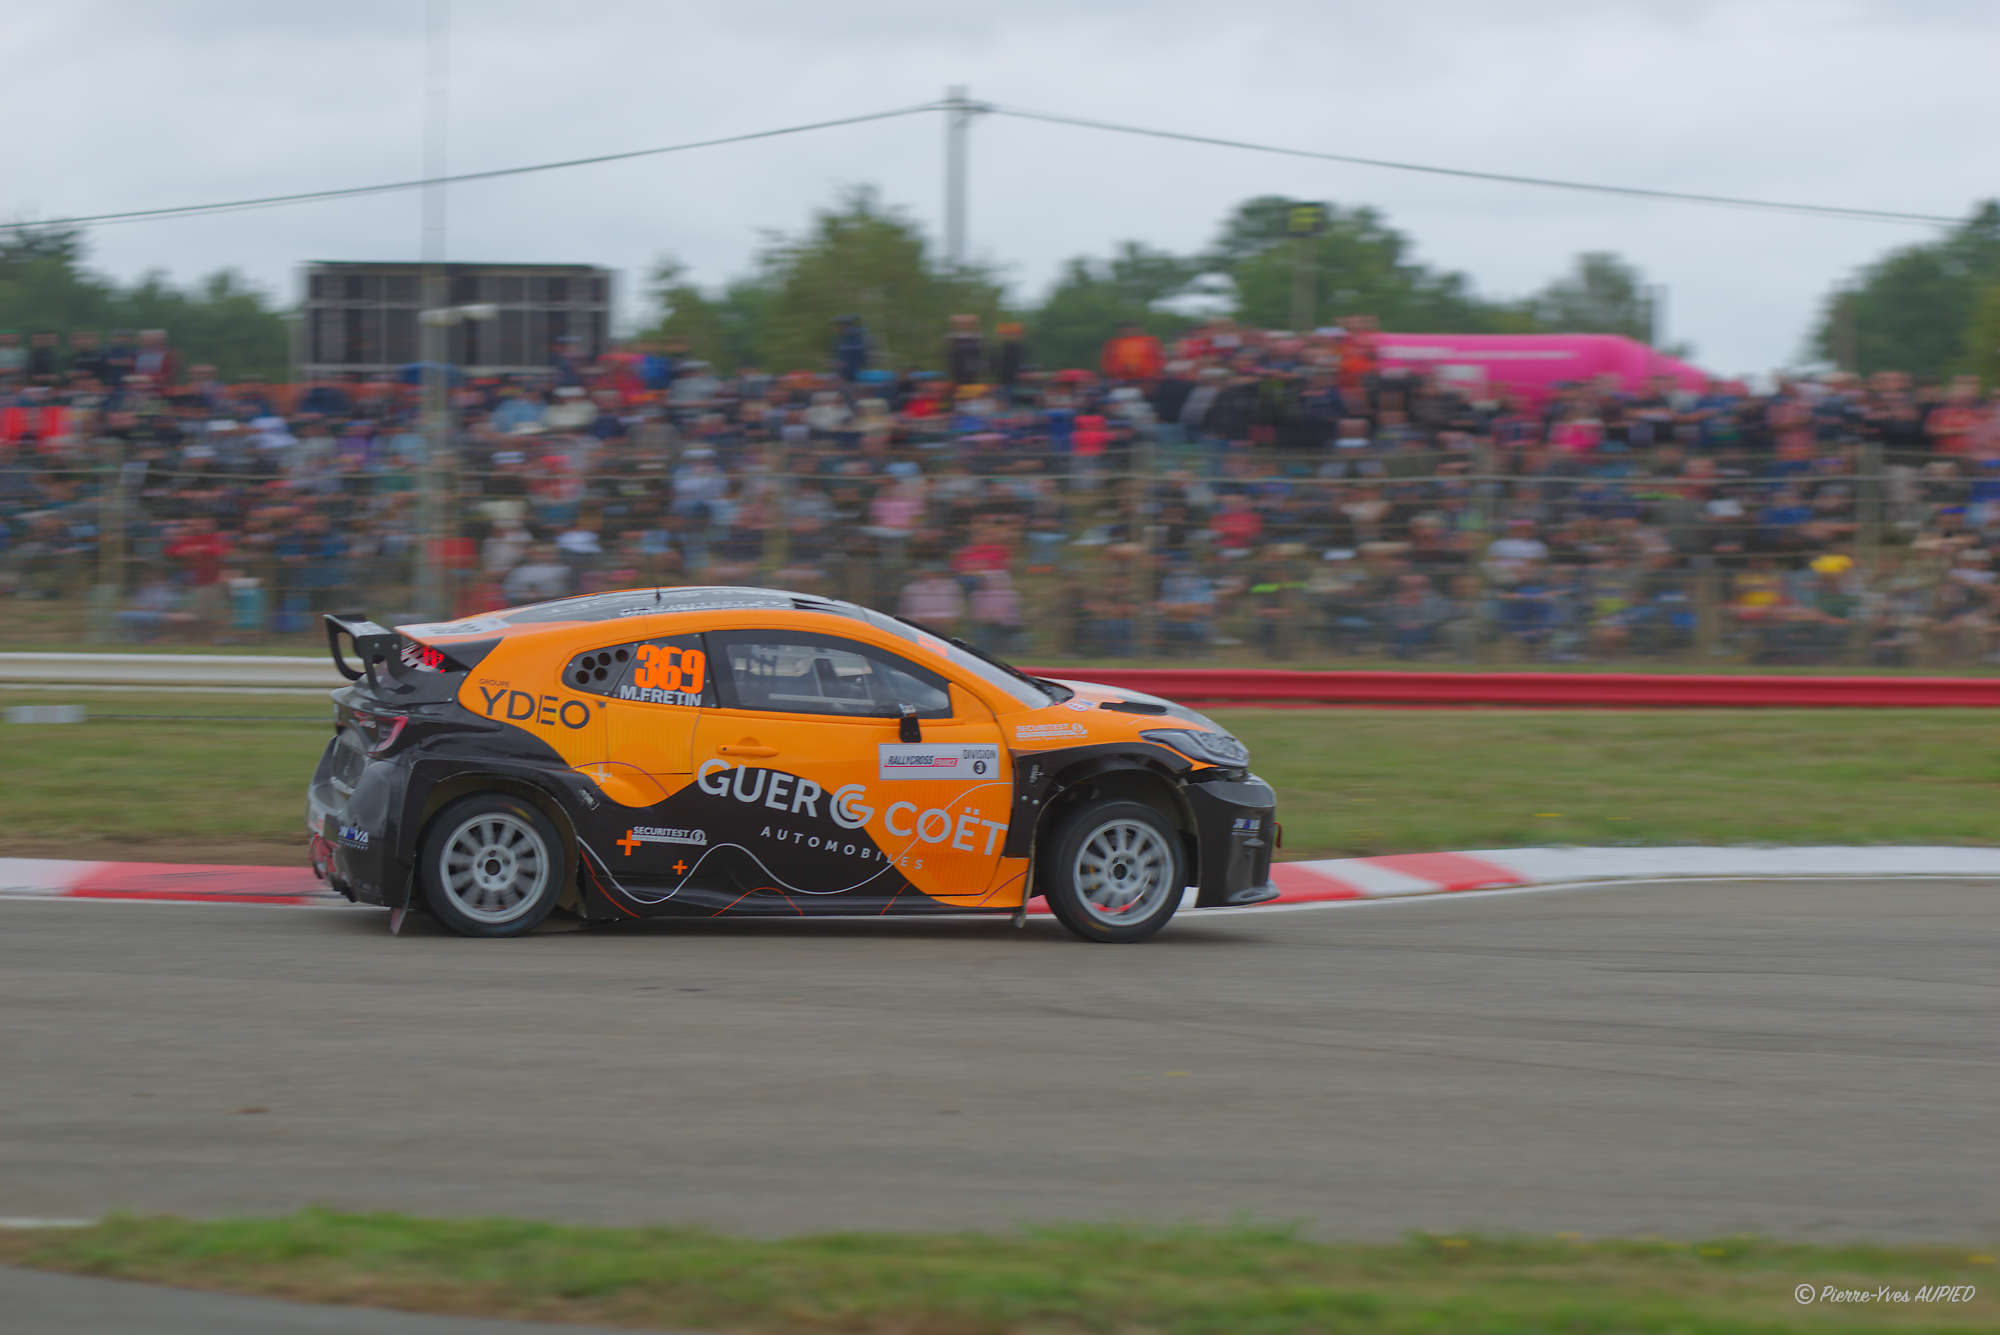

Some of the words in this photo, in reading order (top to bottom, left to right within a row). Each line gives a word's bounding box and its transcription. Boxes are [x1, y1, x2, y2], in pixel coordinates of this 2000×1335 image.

[634, 644, 706, 694] 369
[479, 686, 590, 729] YDEO
[620, 685, 702, 707] M.FRETIN
[887, 755, 934, 766] RALLYCROSS
[962, 749, 996, 760] DIVISION
[698, 758, 822, 818] GUER
[884, 801, 1009, 856] COËT
[633, 826, 690, 838] SECURITEST
[760, 825, 924, 870] AUTOMOBILES
